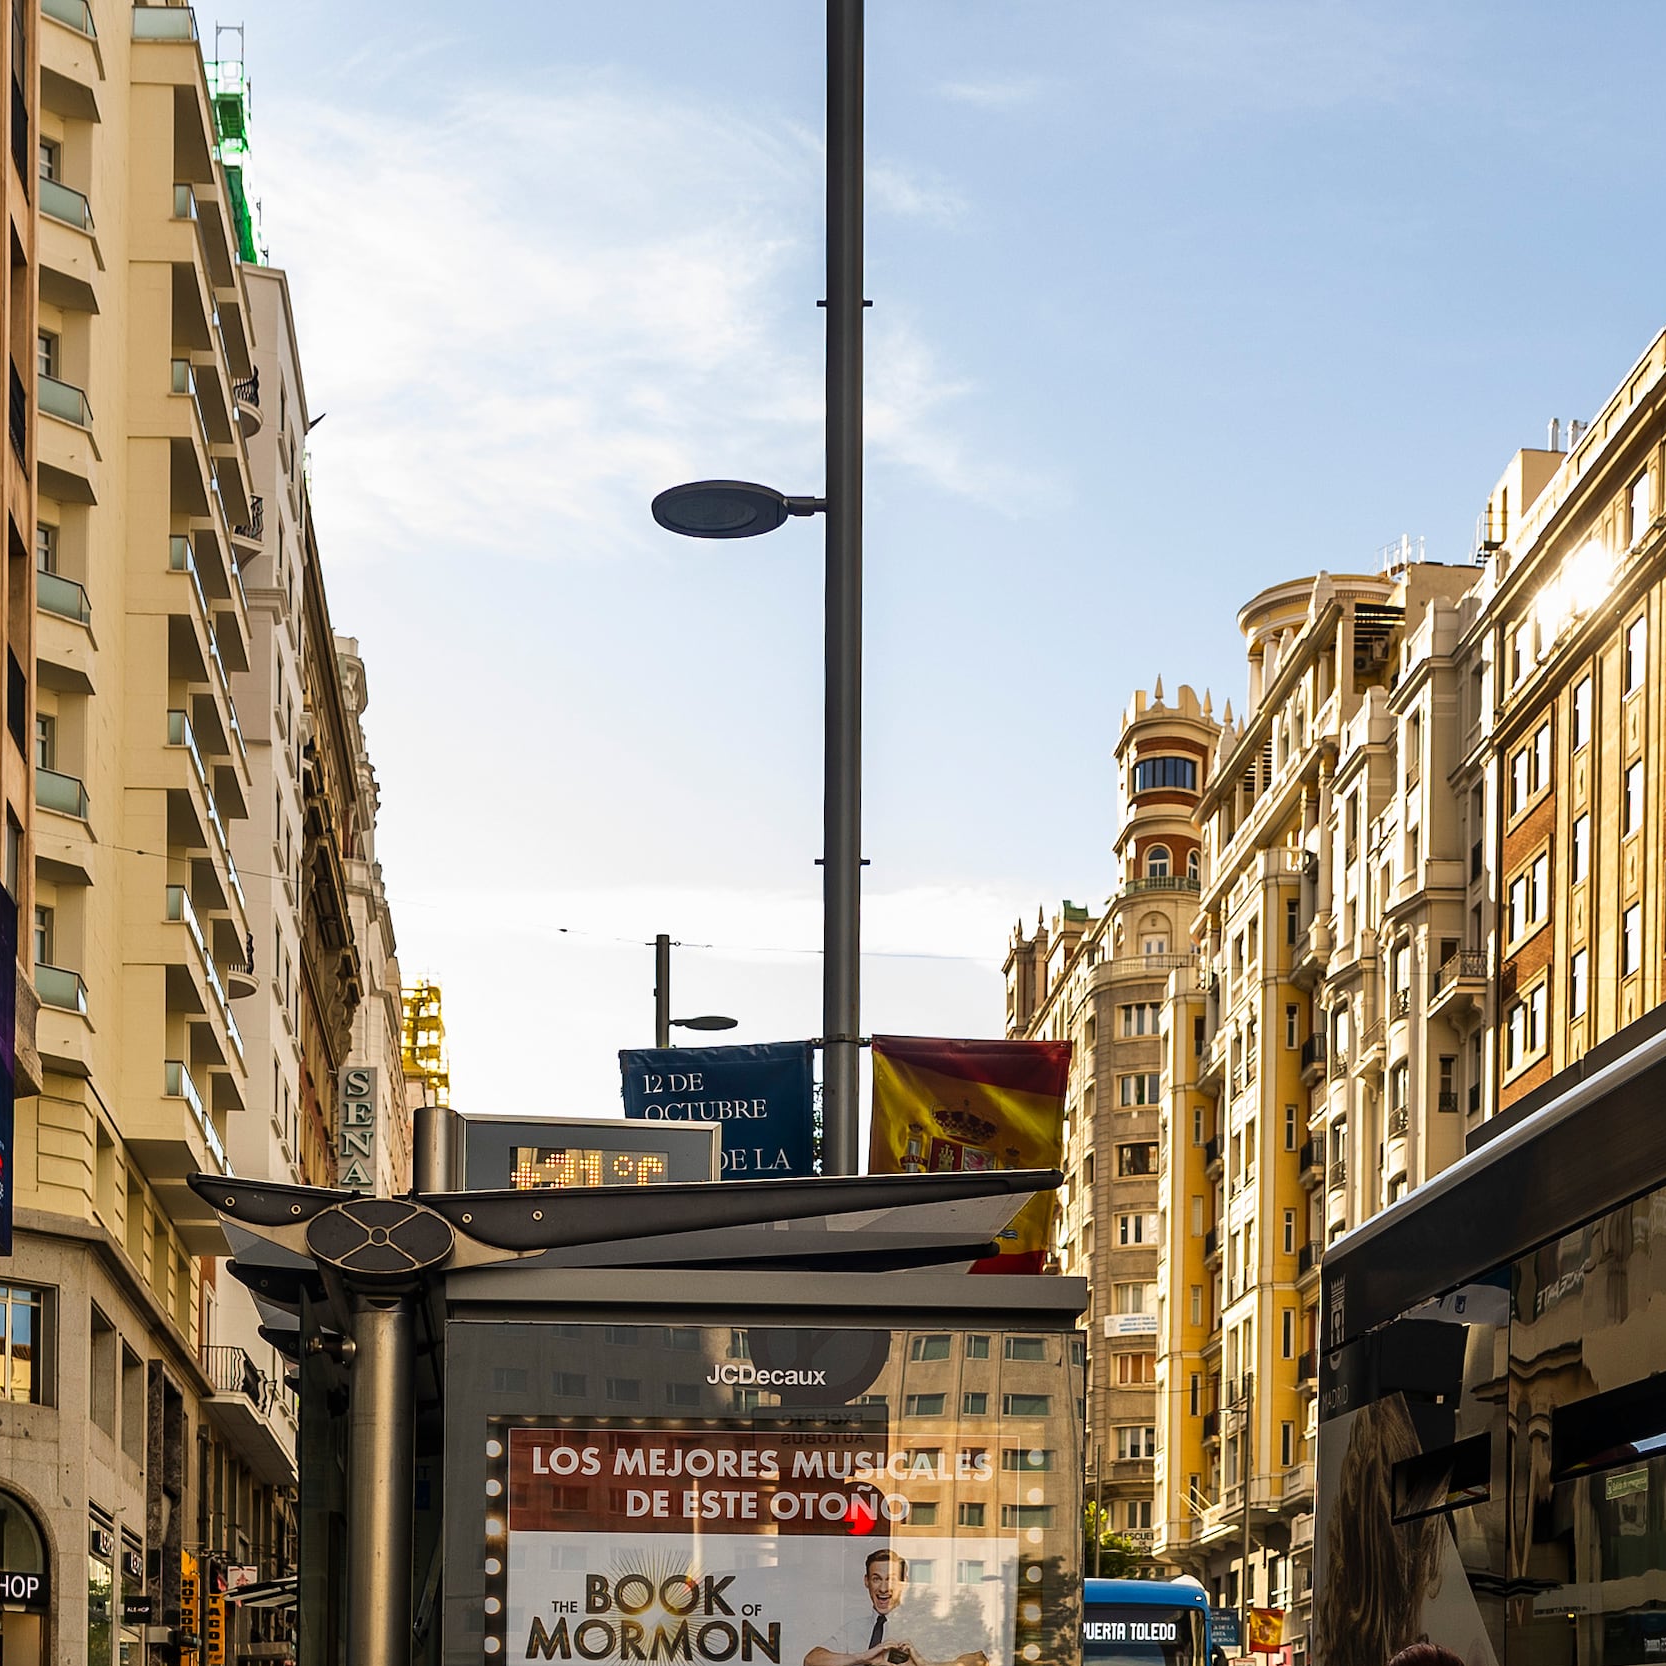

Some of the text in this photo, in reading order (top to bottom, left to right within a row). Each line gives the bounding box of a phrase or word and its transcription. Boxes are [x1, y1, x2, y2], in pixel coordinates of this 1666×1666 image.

[643, 1073, 704, 1094] 12 DE
[644, 1099, 768, 1121] OCTUBRE
[340, 1071, 373, 1188] SENA
[753, 1148, 792, 1171] LA
[706, 1364, 827, 1386] JCDecaux
[532, 1446, 993, 1482] LOS MEJORES MUSICALES
[626, 1485, 910, 1522] DE ESTE OTOÑO
[585, 1573, 736, 1616] BOOK
[551, 1600, 762, 1617] THE OF
[525, 1616, 782, 1665] MORMON
[1130, 1623, 1176, 1641] TOLEDO
